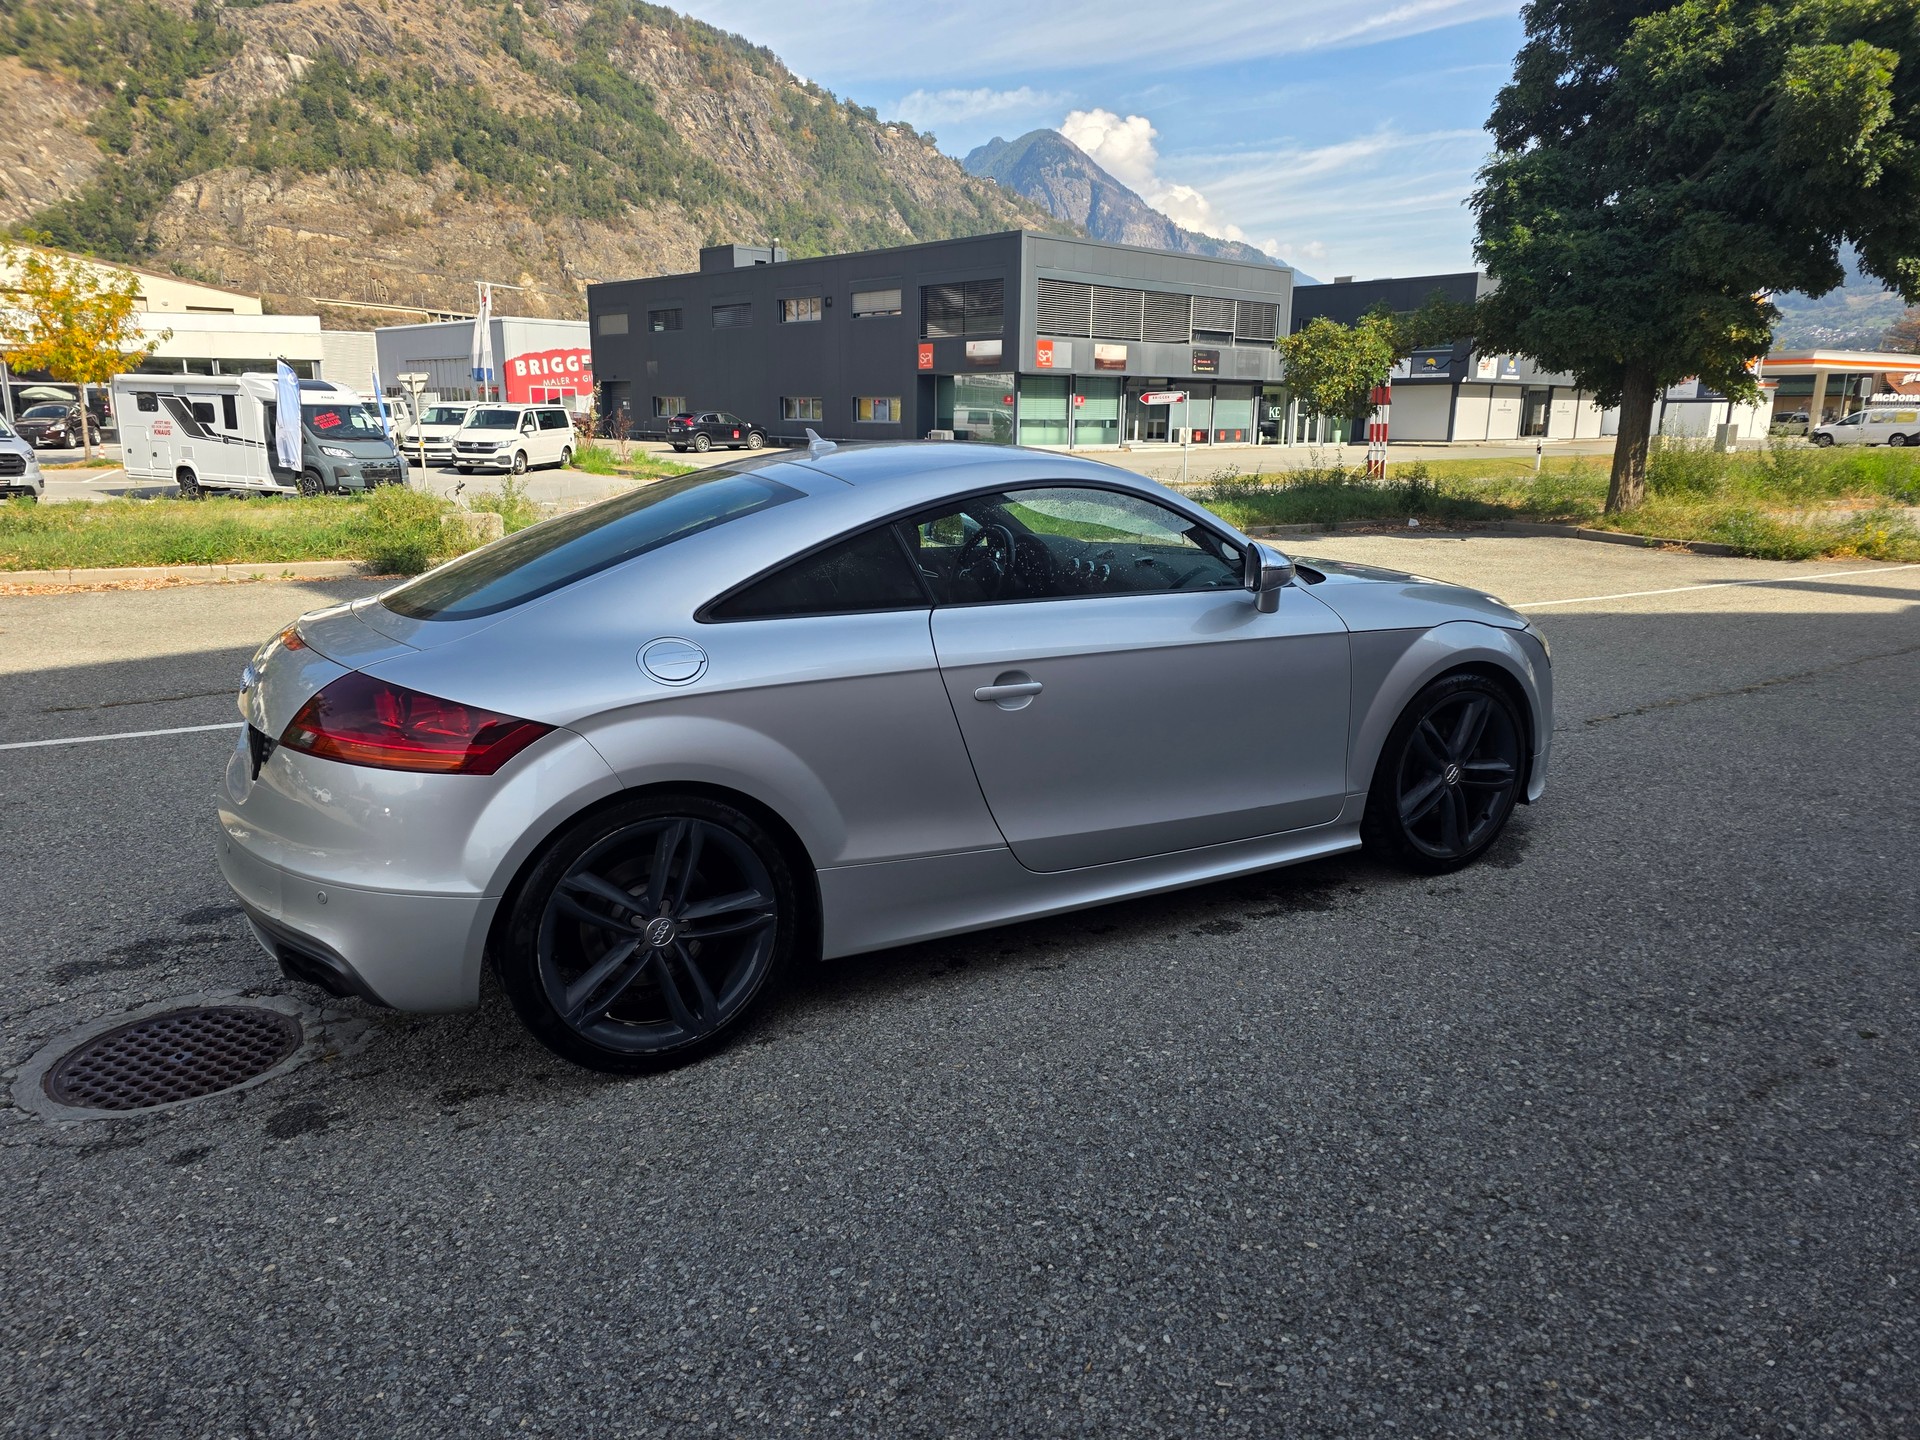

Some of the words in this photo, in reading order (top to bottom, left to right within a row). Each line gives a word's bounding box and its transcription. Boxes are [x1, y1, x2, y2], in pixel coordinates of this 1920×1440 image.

[919, 352, 932, 364] SPI
[1038, 349, 1052, 362] SPI
[543, 377, 570, 386] MALER
